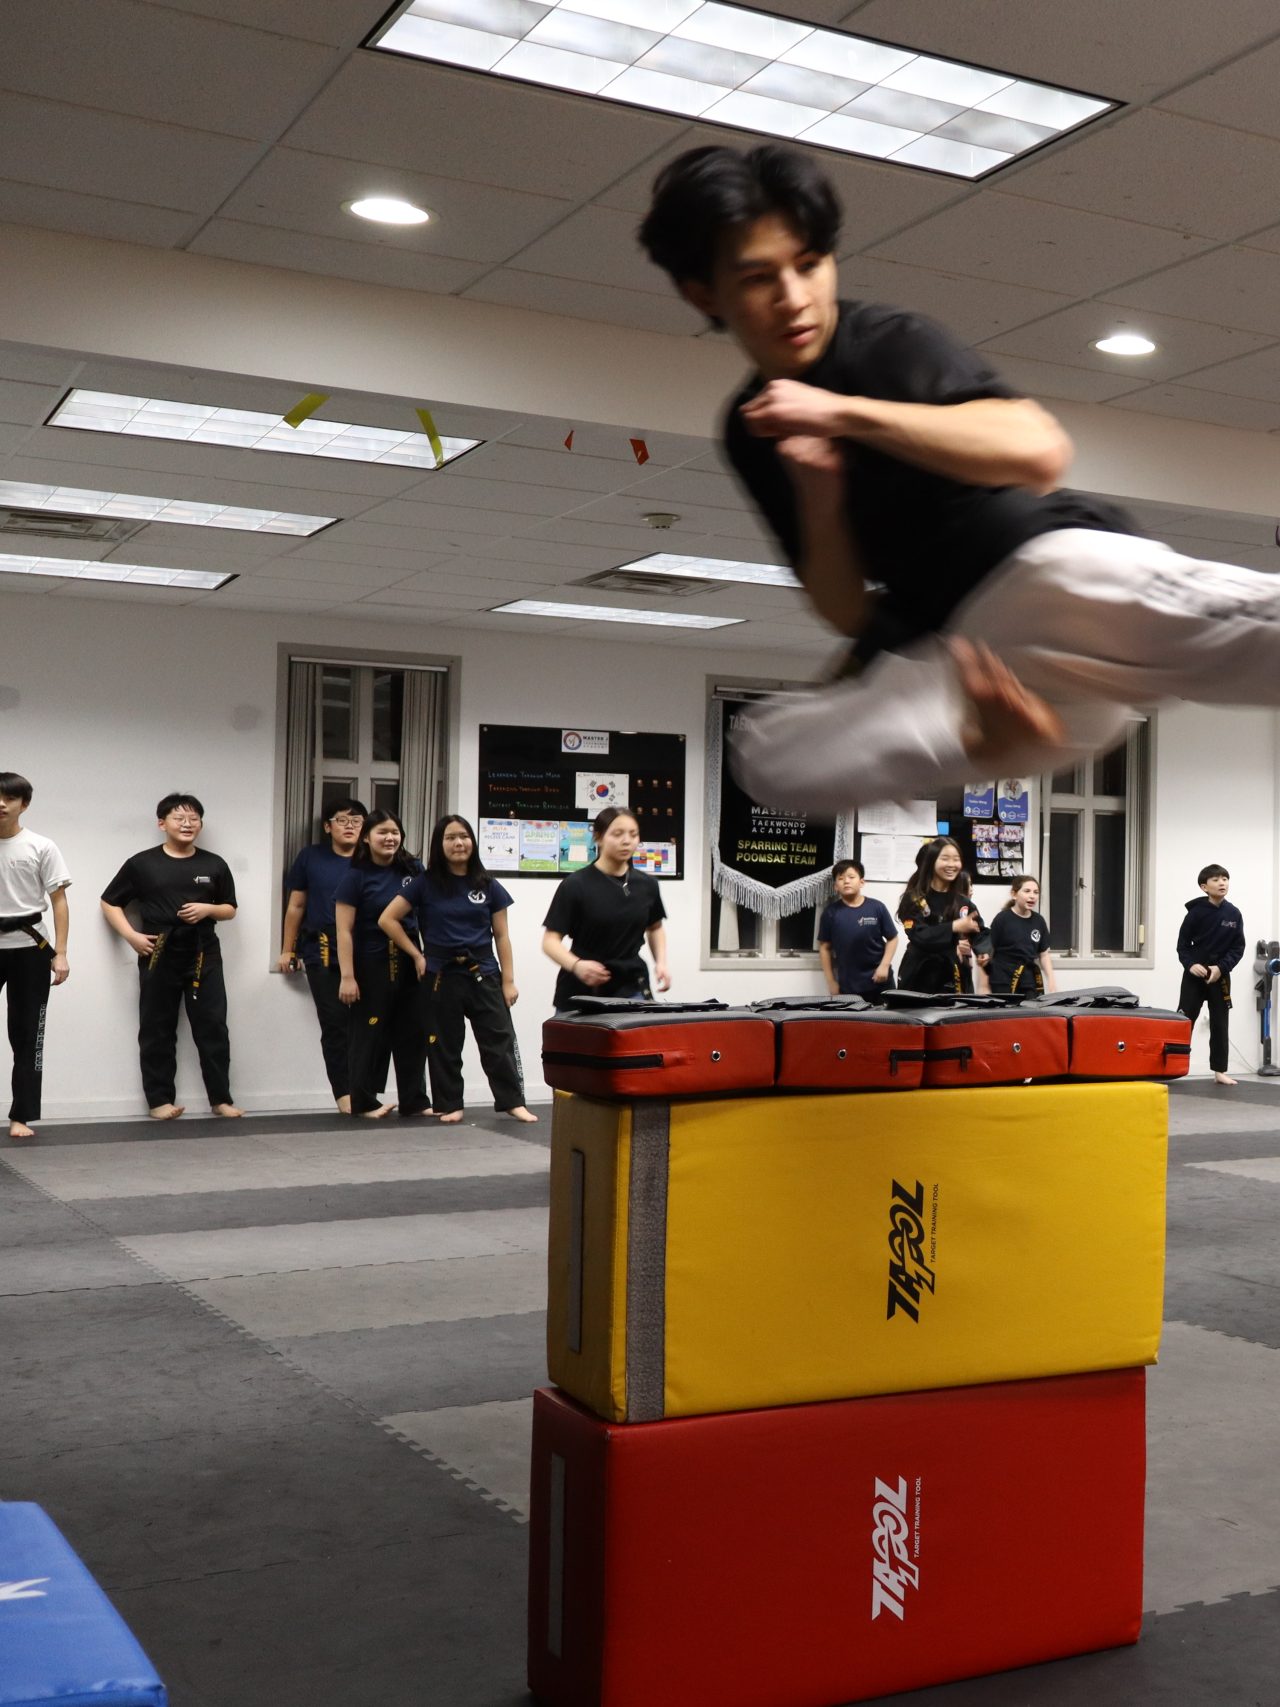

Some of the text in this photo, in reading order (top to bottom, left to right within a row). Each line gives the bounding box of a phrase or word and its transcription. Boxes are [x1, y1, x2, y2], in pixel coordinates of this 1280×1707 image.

[751, 819, 806, 829] TAEKWONDO
[751, 827, 805, 836] ACADEMY
[737, 839, 817, 853] SPARRING TEAM
[736, 852, 816, 865] POOMSAE TEAM
